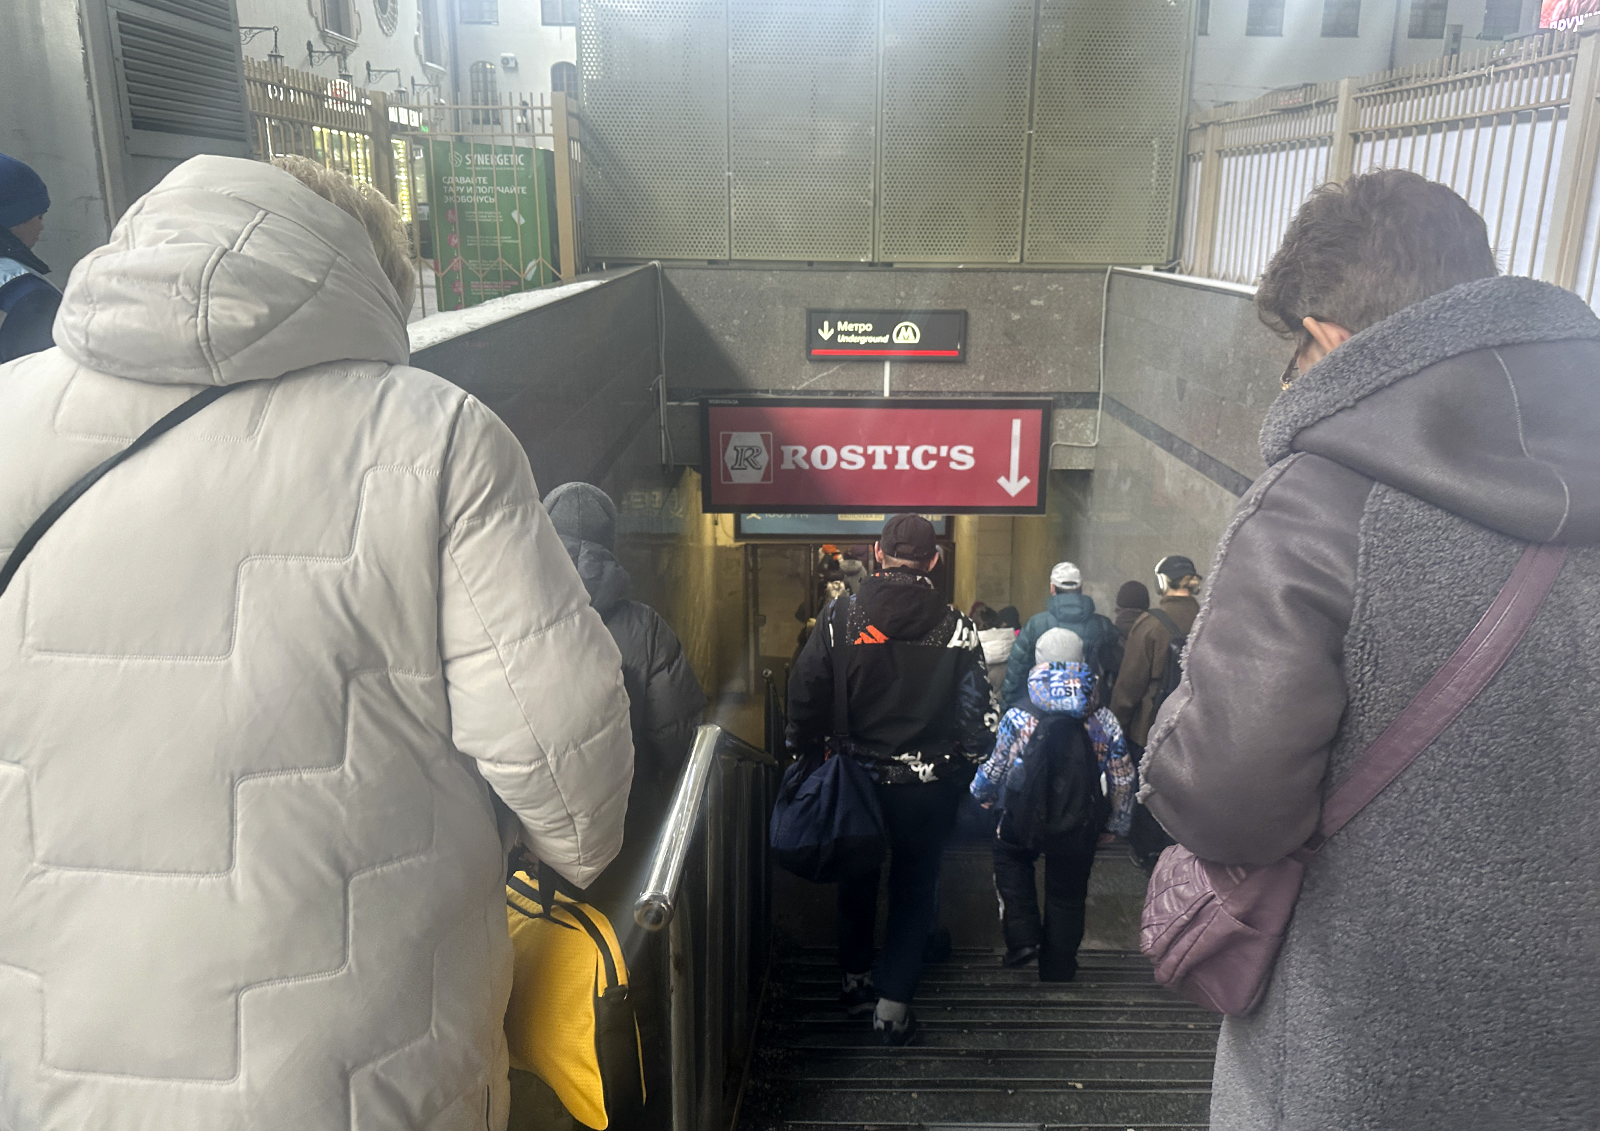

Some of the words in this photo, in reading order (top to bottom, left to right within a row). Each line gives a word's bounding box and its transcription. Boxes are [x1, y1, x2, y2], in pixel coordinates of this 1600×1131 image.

[837, 321, 873, 334] Метро
[837, 334, 890, 345] Underground
[780, 445, 976, 470] ROSTIC'S
